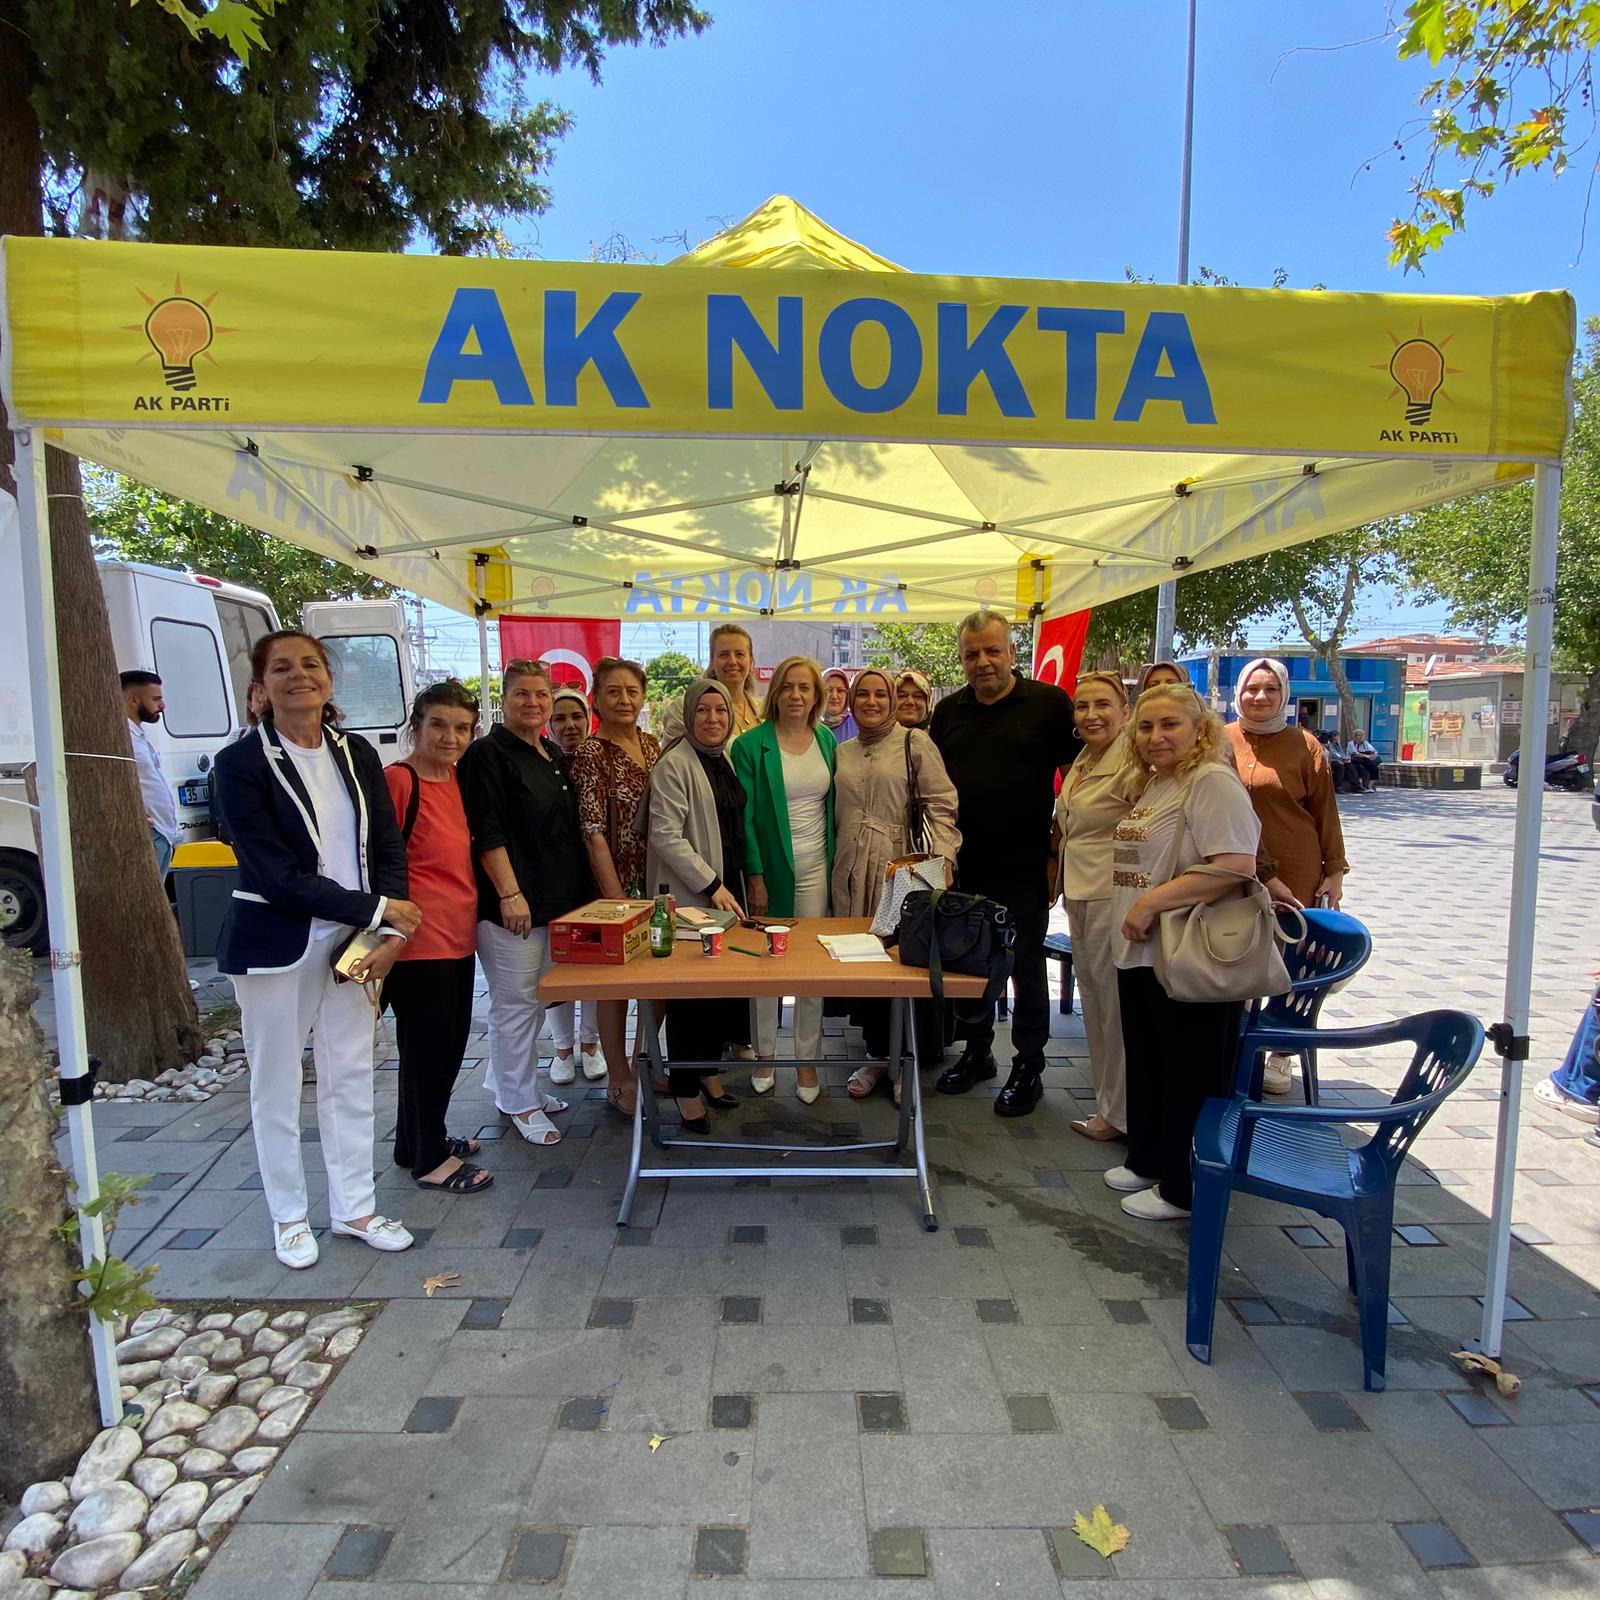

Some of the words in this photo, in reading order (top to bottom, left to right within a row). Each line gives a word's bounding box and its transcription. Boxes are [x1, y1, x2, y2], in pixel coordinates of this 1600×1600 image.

[417, 287, 651, 408] AK
[707, 294, 1218, 426] NOKTA
[134, 396, 164, 411] AK
[1379, 429, 1405, 442] AK
[187, 788, 198, 801] 35
